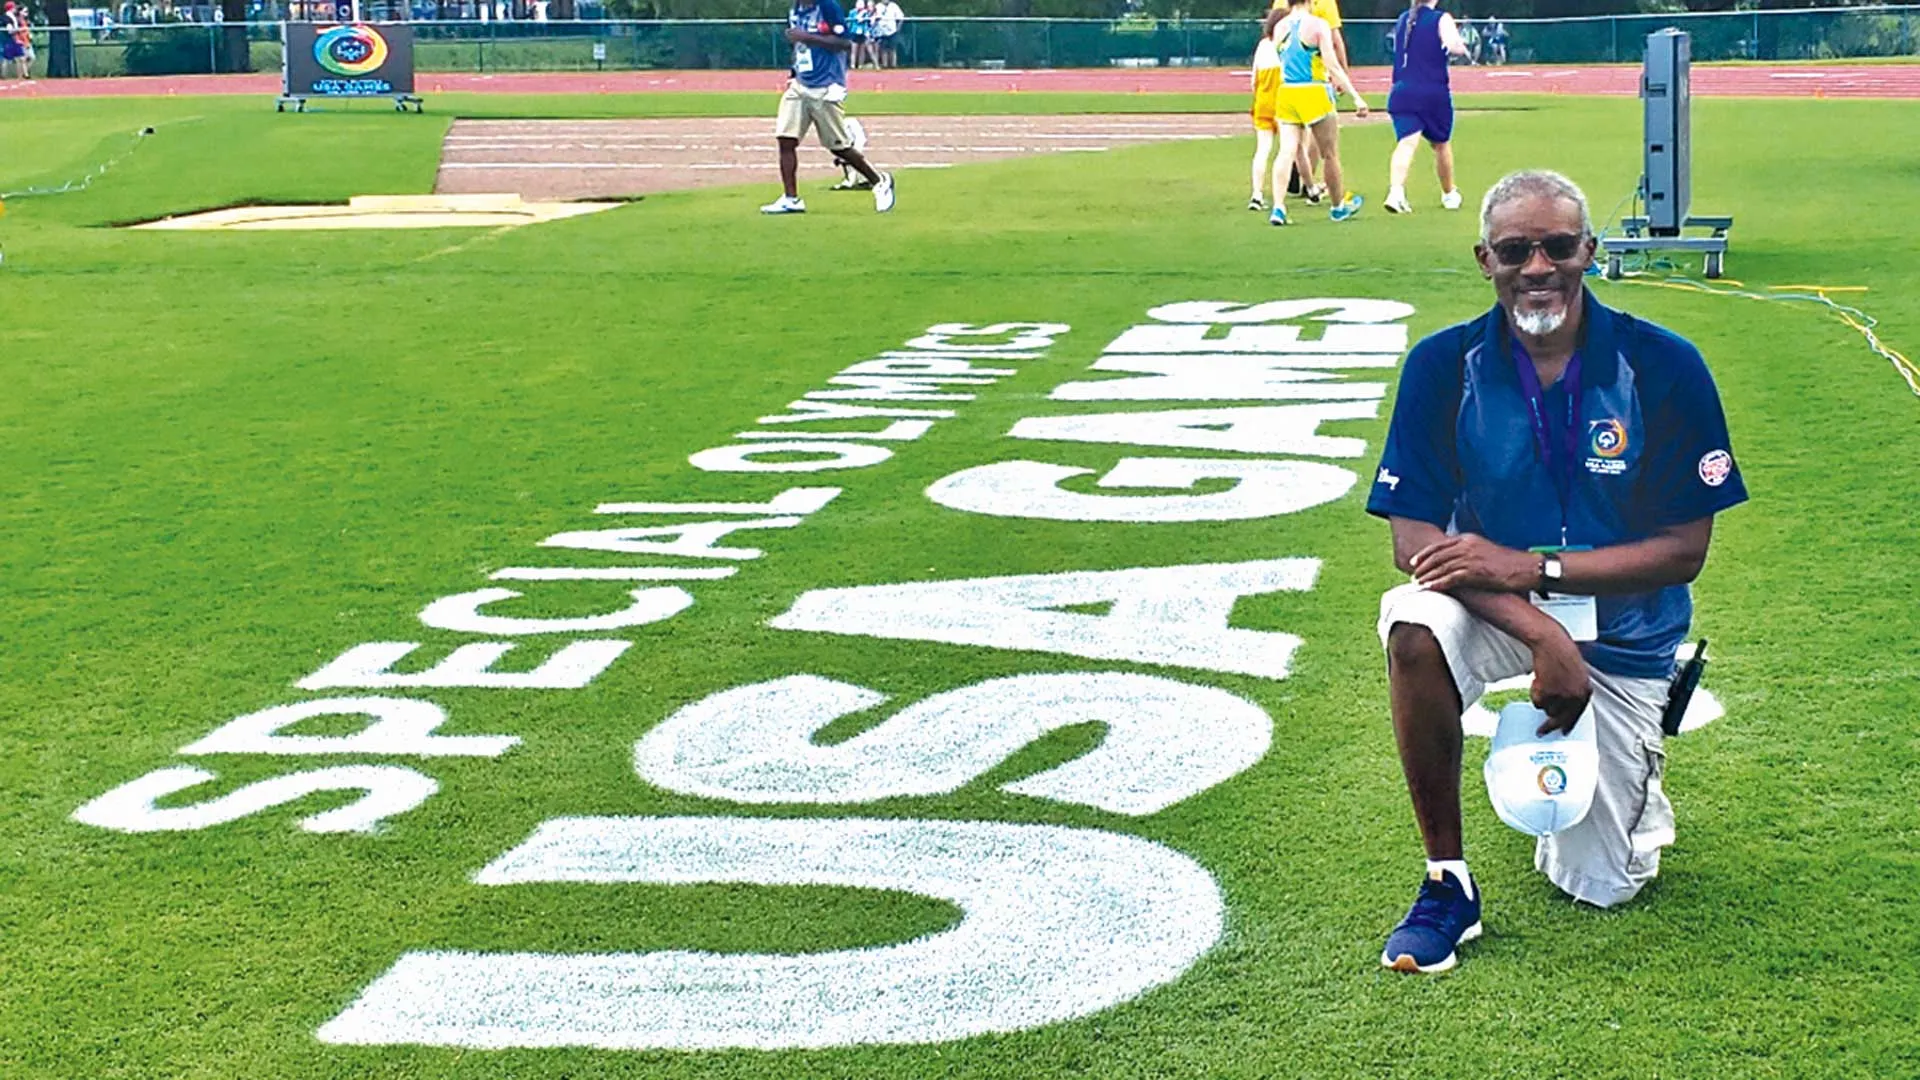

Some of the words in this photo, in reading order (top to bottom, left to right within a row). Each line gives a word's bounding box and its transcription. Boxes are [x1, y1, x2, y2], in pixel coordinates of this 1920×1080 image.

[72, 486, 842, 835] SPECIAL
[688, 322, 1071, 472] OLYMPICS
[315, 556, 1324, 1051] USA
[925, 297, 1416, 522] GAMES
